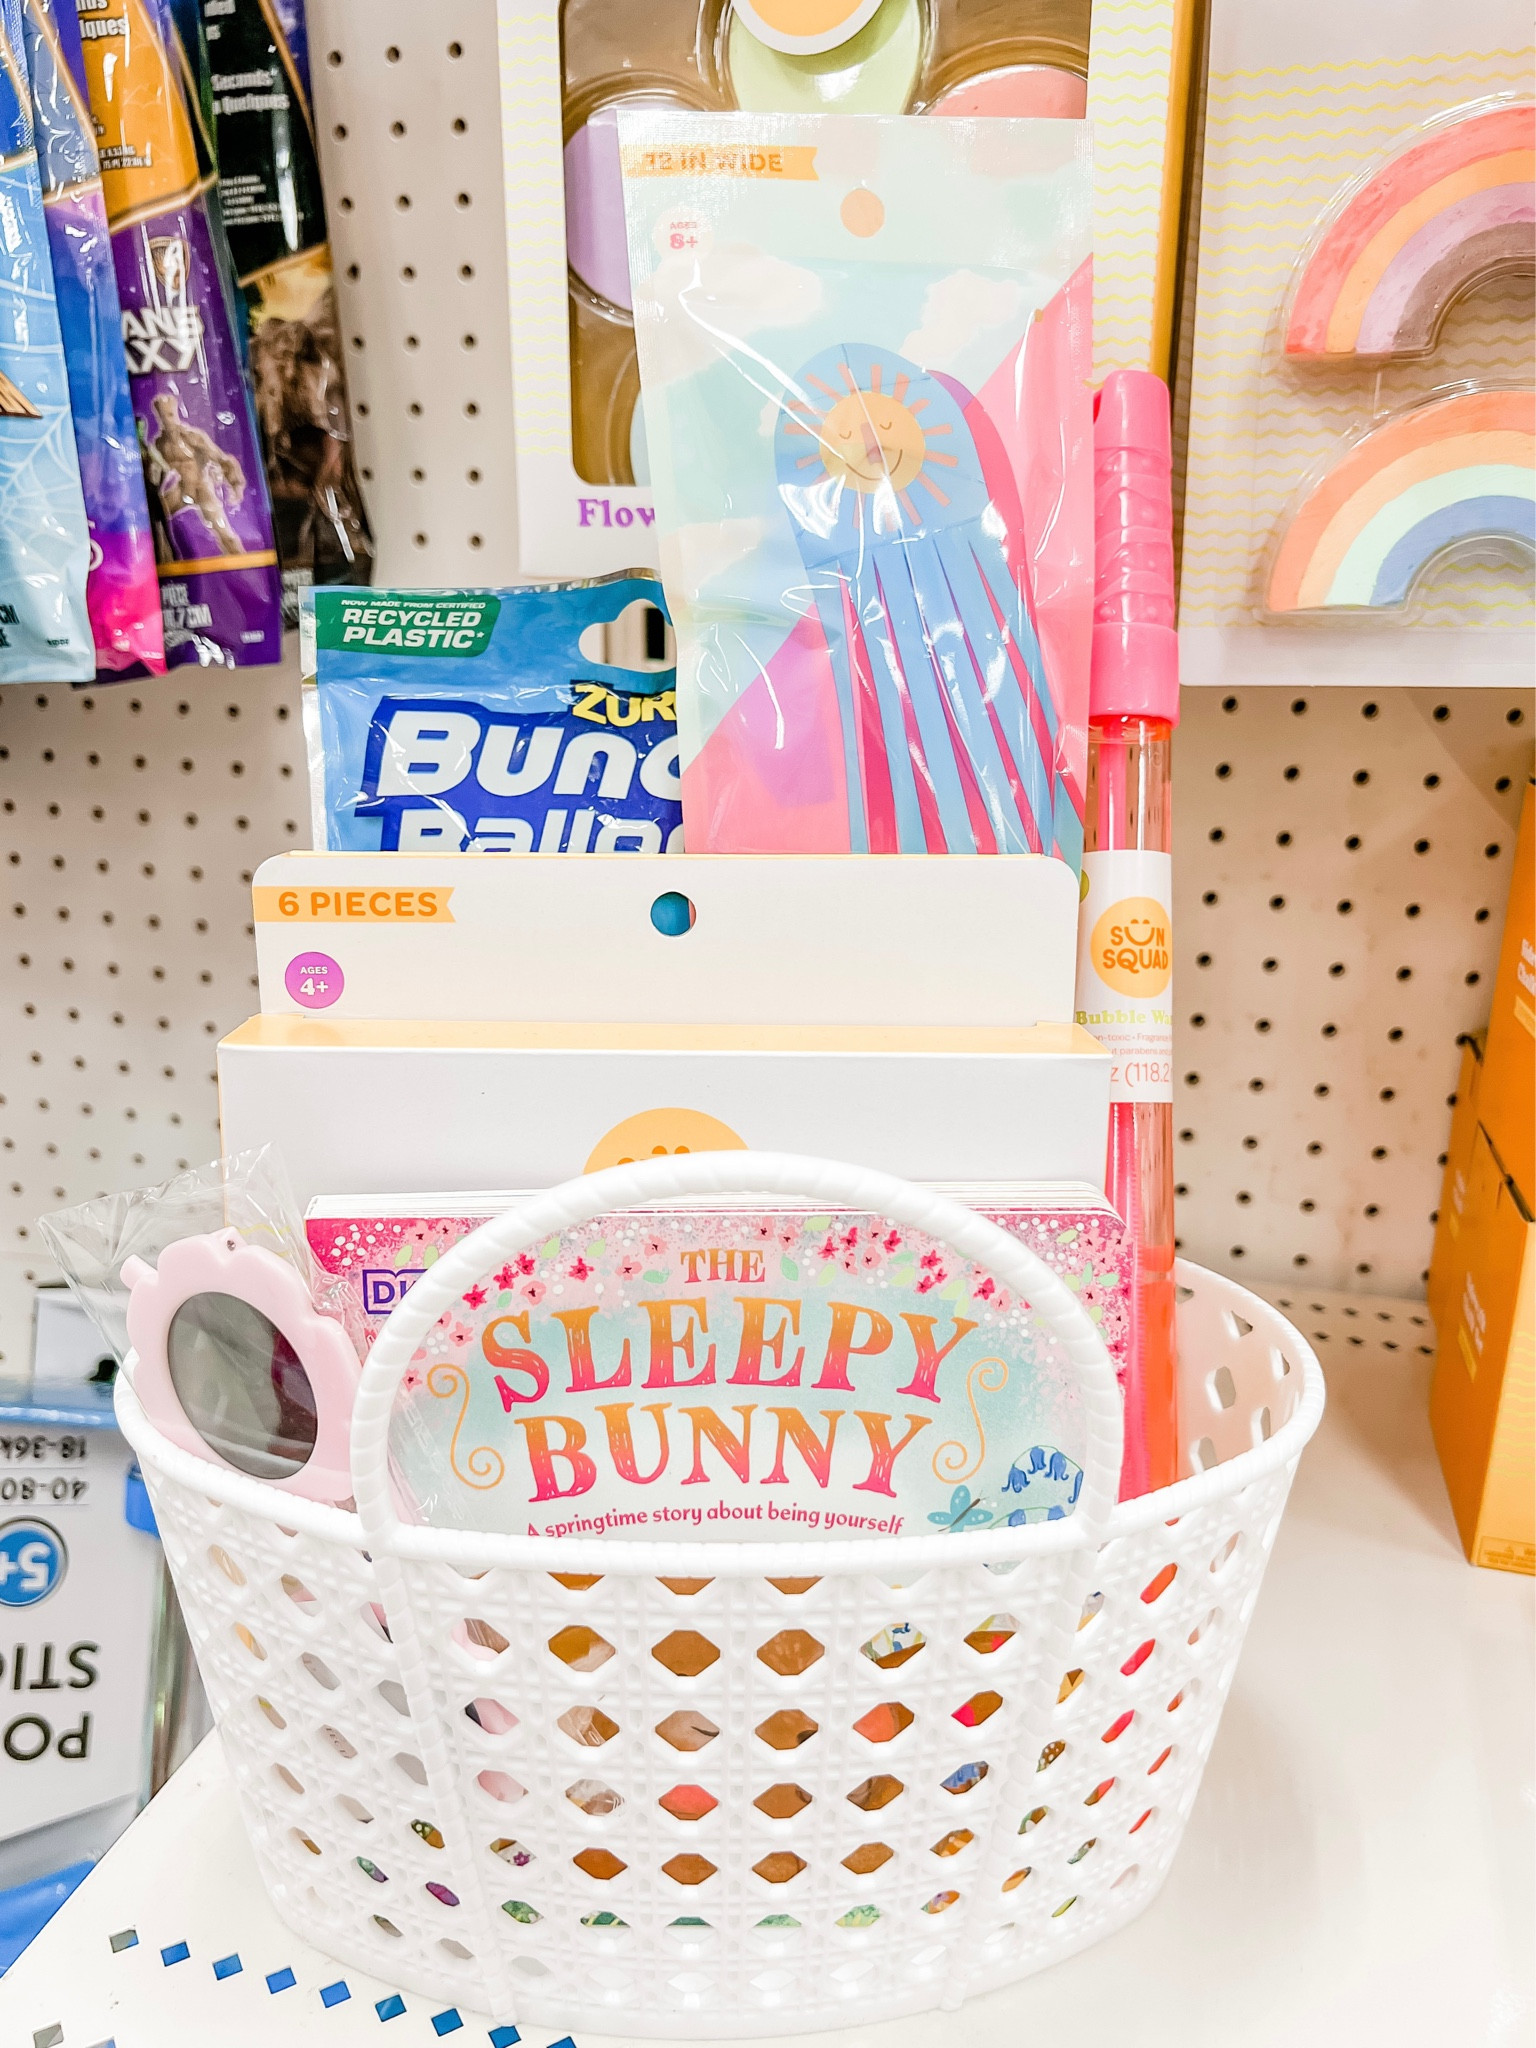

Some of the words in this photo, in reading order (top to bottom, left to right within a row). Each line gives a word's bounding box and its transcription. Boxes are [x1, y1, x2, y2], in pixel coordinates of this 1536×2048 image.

[717, 152, 784, 172] WIDE
[342, 608, 482, 627] RECYCLED
[572, 683, 678, 727] ZUR
[278, 891, 300, 917] 6
[311, 891, 438, 917] PIECES
[1110, 918, 1165, 947] SUN
[300, 966, 328, 976] AGES
[1102, 948, 1169, 973] SQUAD
[299, 977, 329, 997] 4+
[1076, 1009, 1147, 1025] Bubble
[680, 1248, 766, 1284] THE
[480, 1297, 979, 1412] SLEEPY
[514, 1401, 932, 1503] BUNNY
[545, 1508, 648, 1538] springtime
[652, 1506, 702, 1526] story
[706, 1500, 763, 1520] about
[768, 1501, 820, 1528] being
[824, 1512, 905, 1535] yourself
[0, 1641, 100, 1690] STI
[4, 1711, 92, 1761] PO
